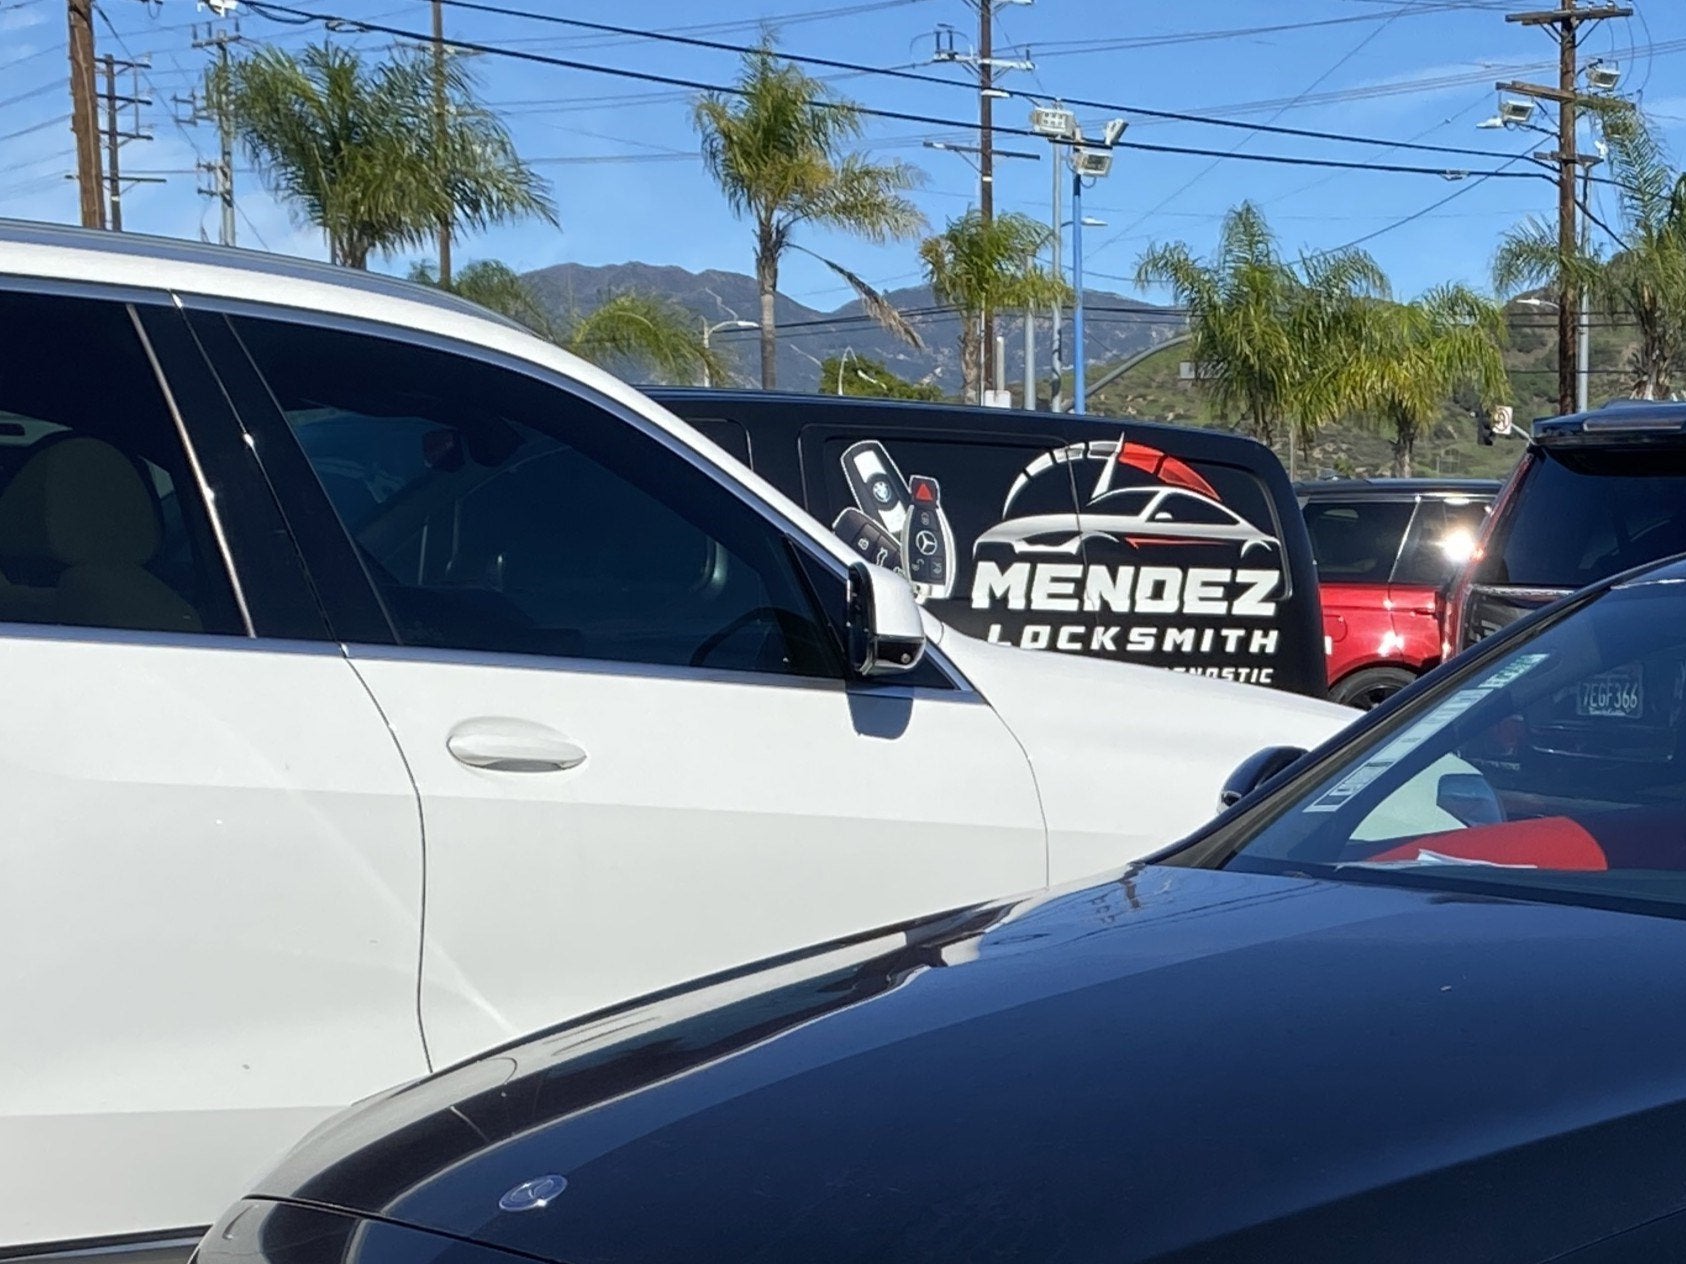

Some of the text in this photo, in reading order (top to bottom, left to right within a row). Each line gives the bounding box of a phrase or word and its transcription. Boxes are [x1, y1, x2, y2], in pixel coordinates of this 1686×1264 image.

[971, 560, 1280, 617] MENDEZ
[987, 623, 1279, 654] LOCKSMITH
[1582, 682, 1638, 709] 7EGF366
